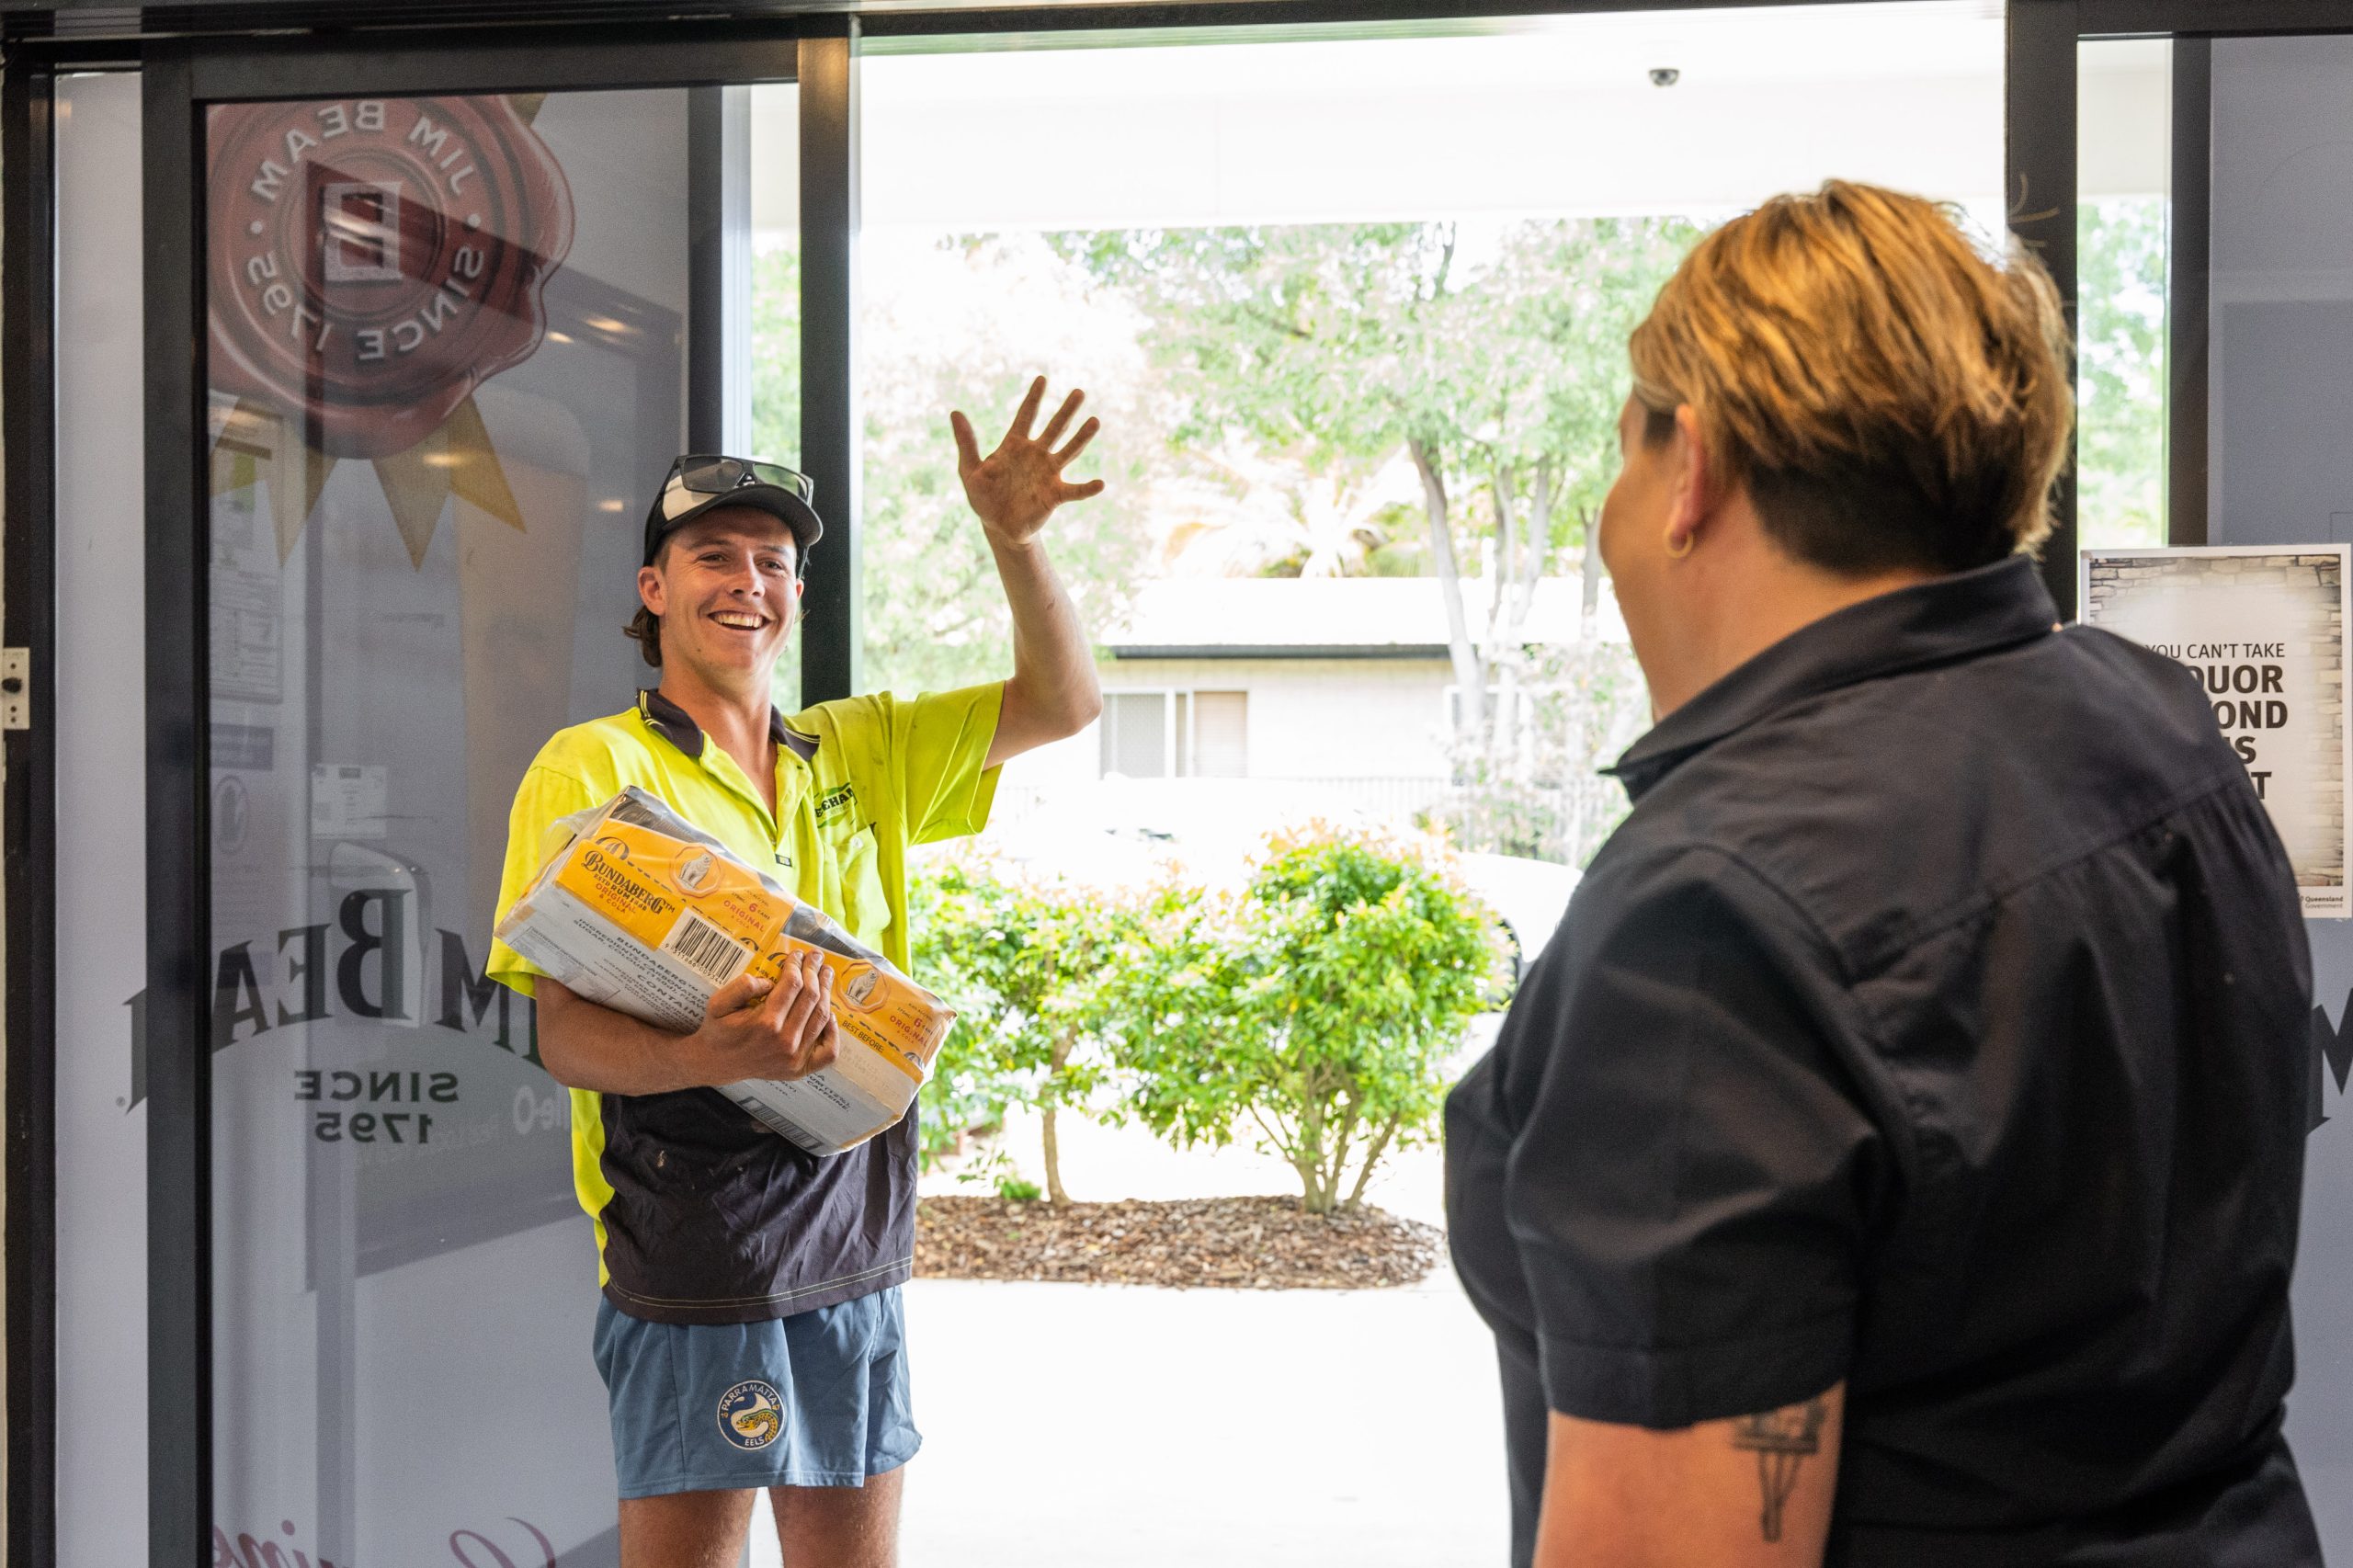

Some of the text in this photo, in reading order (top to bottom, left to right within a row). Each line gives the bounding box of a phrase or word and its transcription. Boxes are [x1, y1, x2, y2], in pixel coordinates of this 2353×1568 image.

[2187, 643, 2238, 659] CAN'T
[2243, 643, 2286, 658] TAKE
[596, 882, 636, 914] ORIGINAL
[611, 885, 631, 899] RUM
[607, 898, 626, 913] COLA
[749, 903, 758, 913] 6
[723, 900, 765, 932] ORIGINAL
[915, 1017, 923, 1028] 6
[842, 1021, 885, 1053] BEST BEFORE:
[721, 1384, 778, 1412] PARRAMATTA
[745, 1436, 765, 1447] EELS
